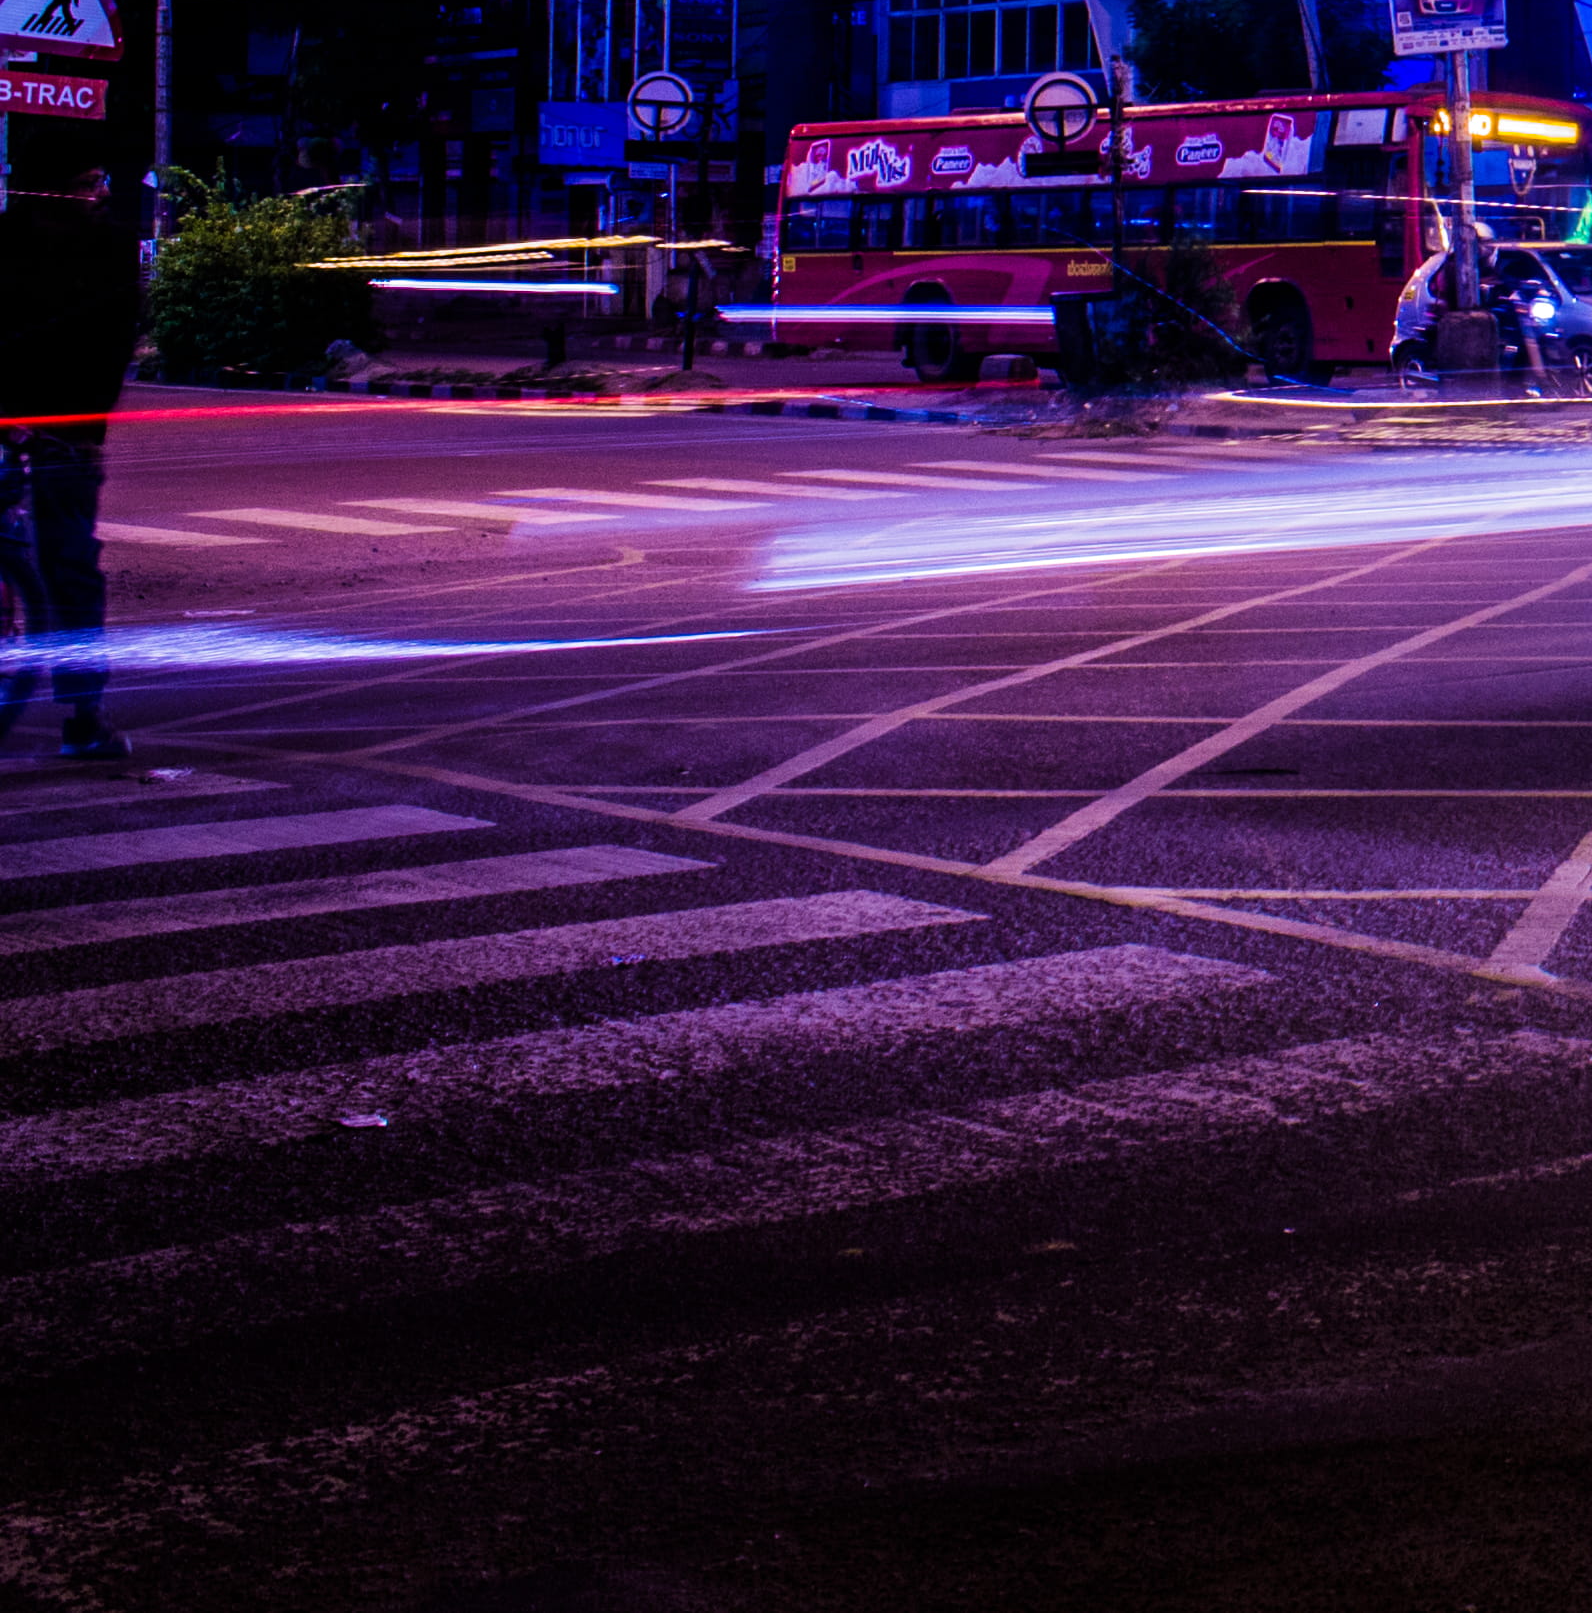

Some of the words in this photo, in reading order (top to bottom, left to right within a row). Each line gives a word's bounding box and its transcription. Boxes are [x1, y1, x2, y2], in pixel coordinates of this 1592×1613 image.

[540, 113, 606, 148] honor
[850, 139, 896, 171] Milky
[936, 158, 971, 172] Paneer
[1178, 144, 1219, 163] Paneer
[876, 156, 910, 184] Mist
